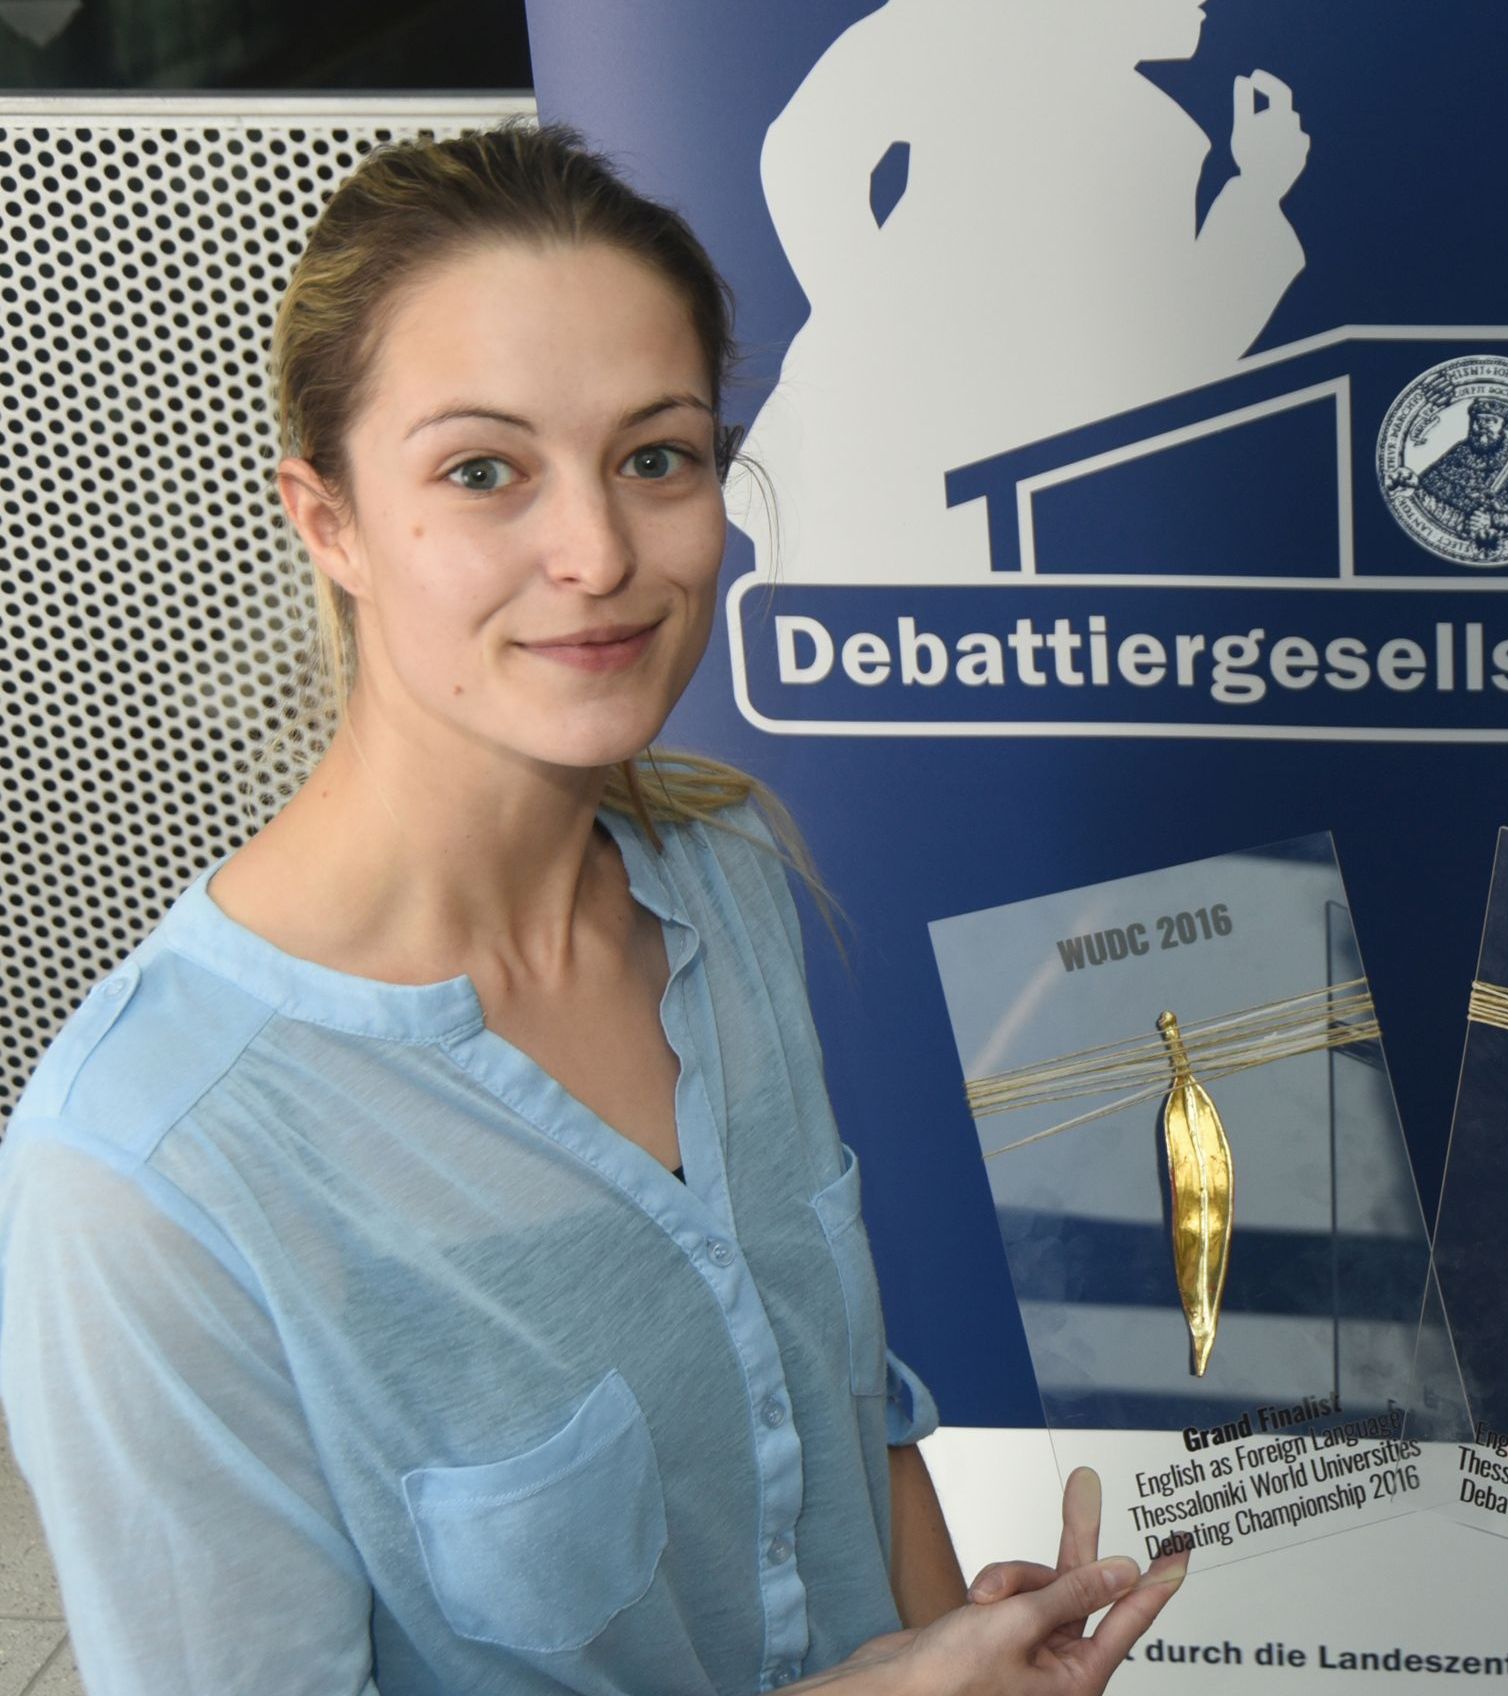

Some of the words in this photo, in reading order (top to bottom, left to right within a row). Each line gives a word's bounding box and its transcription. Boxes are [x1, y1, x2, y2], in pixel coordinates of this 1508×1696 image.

[1056, 922, 1150, 973] WUDC
[1155, 903, 1234, 951] 2016
[1135, 1459, 1205, 1498] English
[1210, 1457, 1233, 1478] as
[1235, 1436, 1307, 1471] Foreign
[1310, 1408, 1407, 1451] Language
[1183, 1414, 1252, 1452] Grand
[1257, 1394, 1343, 1433] Finalist
[1128, 1479, 1248, 1531] Thessaloniki
[1250, 1463, 1308, 1500] World
[1310, 1437, 1422, 1482] Universities
[1145, 1519, 1234, 1561] Debating
[1235, 1483, 1367, 1536] Championship
[1369, 1464, 1421, 1500] 2016
[1145, 1638, 1242, 1665] durch
[1254, 1642, 1306, 1668] die
